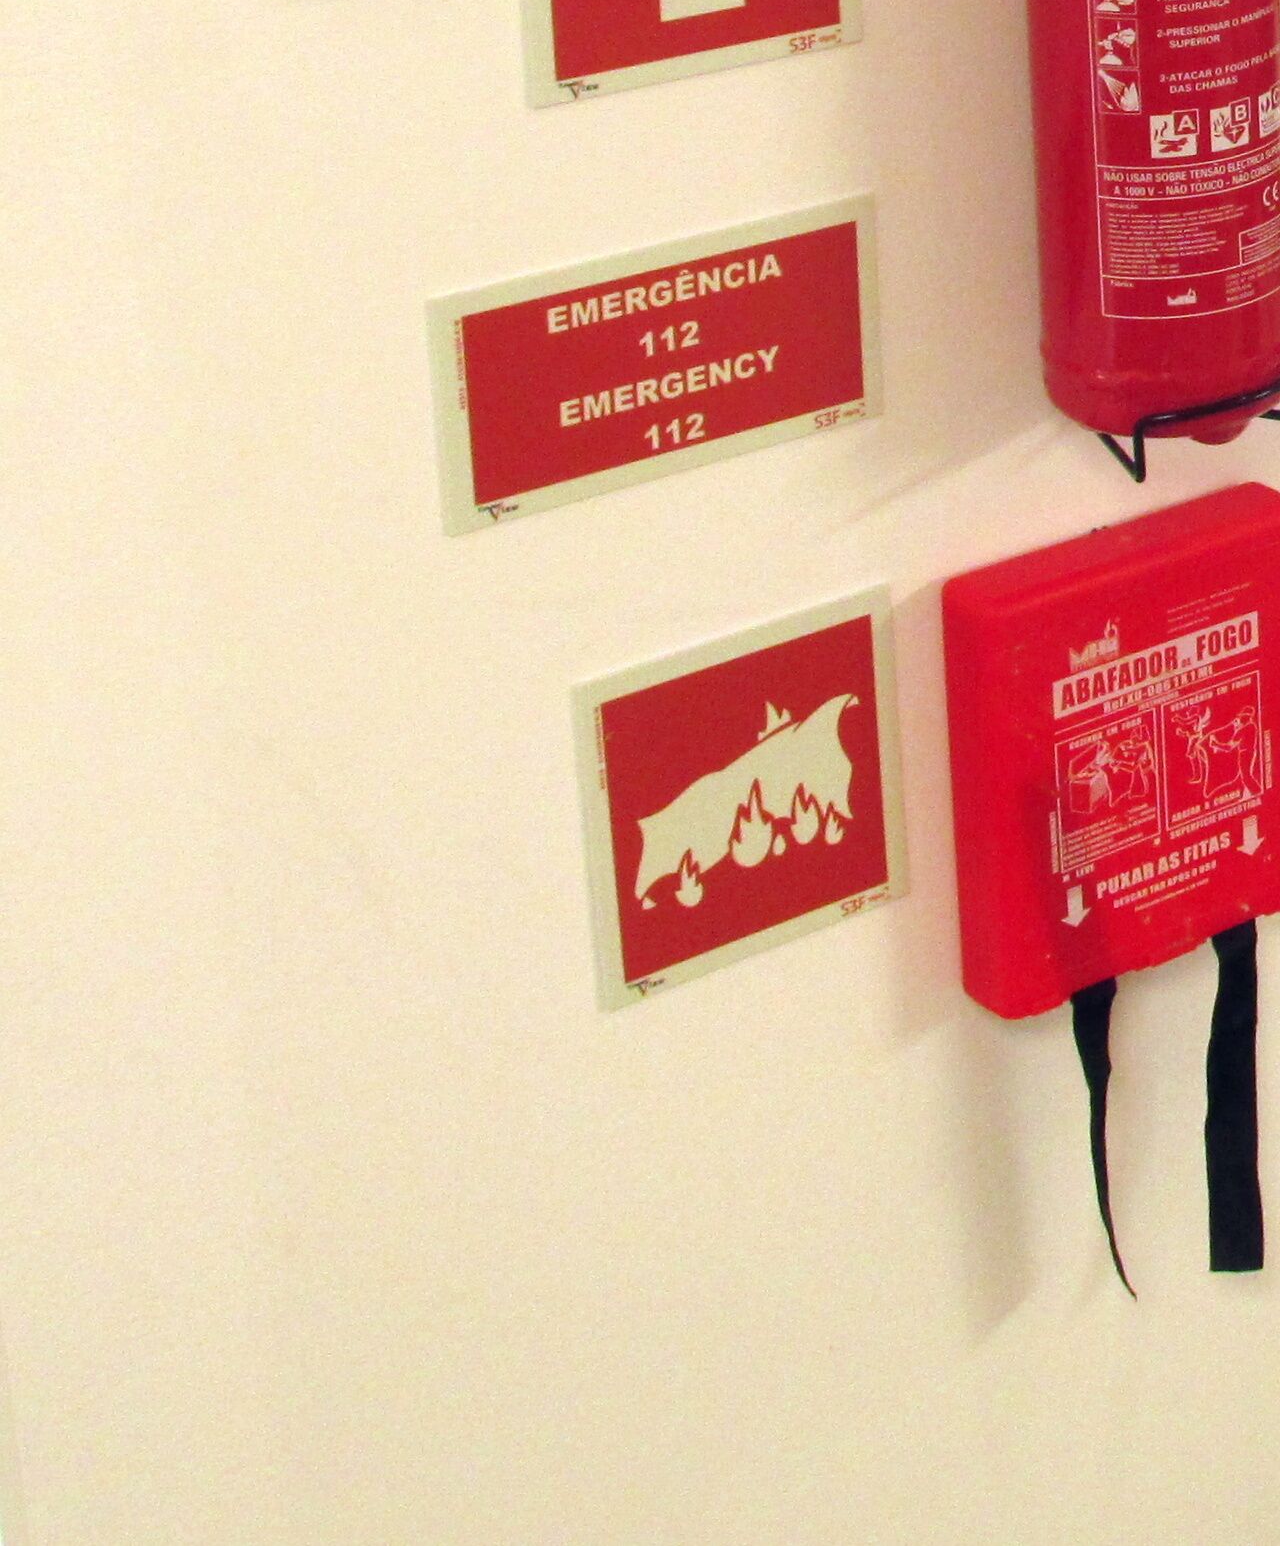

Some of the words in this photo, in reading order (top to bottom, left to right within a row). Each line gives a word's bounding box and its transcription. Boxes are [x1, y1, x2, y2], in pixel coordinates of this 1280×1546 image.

[1168, 34, 1222, 50] SUPERIOR
[1224, 59, 1250, 74] FOGO
[1169, 83, 1193, 95] DAS
[1195, 75, 1240, 92] CHAMAS
[1234, 104, 1248, 122] B
[1177, 115, 1197, 133] A
[1103, 168, 1125, 183] NÃO
[1125, 172, 1153, 183] USAR
[1154, 170, 1188, 183] SOBRE
[1189, 162, 1227, 180] TENSÃO
[1113, 185, 1121, 195] A
[1165, 181, 1188, 196] NÃO
[546, 253, 783, 334] EMERGÊNCIA
[638, 320, 701, 358] 112
[559, 345, 780, 428] EMERGENCY
[643, 413, 706, 450] 112
[1062, 645, 1178, 712] ABAFADOR
[1195, 619, 1253, 662] FOGO
[1096, 862, 1155, 900] PUXAR
[1157, 851, 1181, 875] AS
[1183, 831, 1232, 865] FITAS
